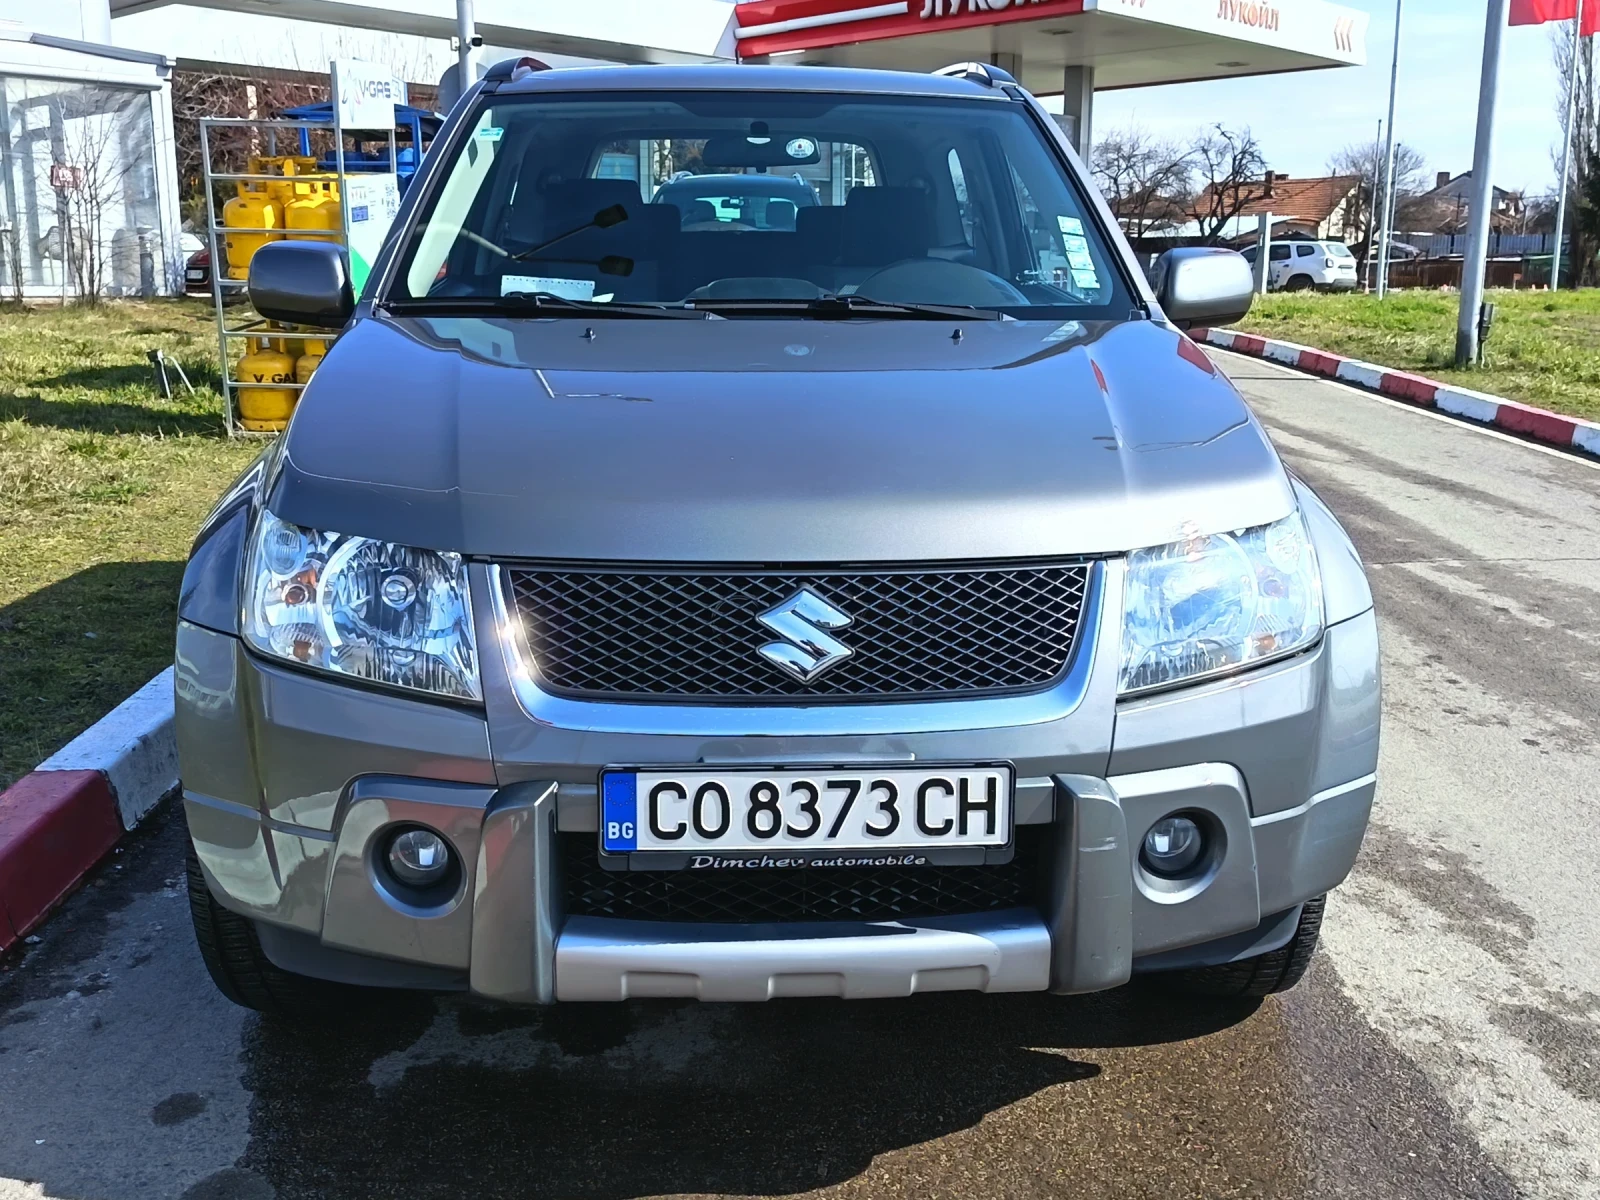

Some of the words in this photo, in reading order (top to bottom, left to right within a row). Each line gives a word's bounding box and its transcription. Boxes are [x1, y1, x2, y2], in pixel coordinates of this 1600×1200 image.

[747, 779, 901, 840] 8373
[916, 776, 996, 837] CH
[607, 822, 634, 839] BG
[690, 854, 804, 870] Dimchev
[810, 854, 926, 869] automobile
